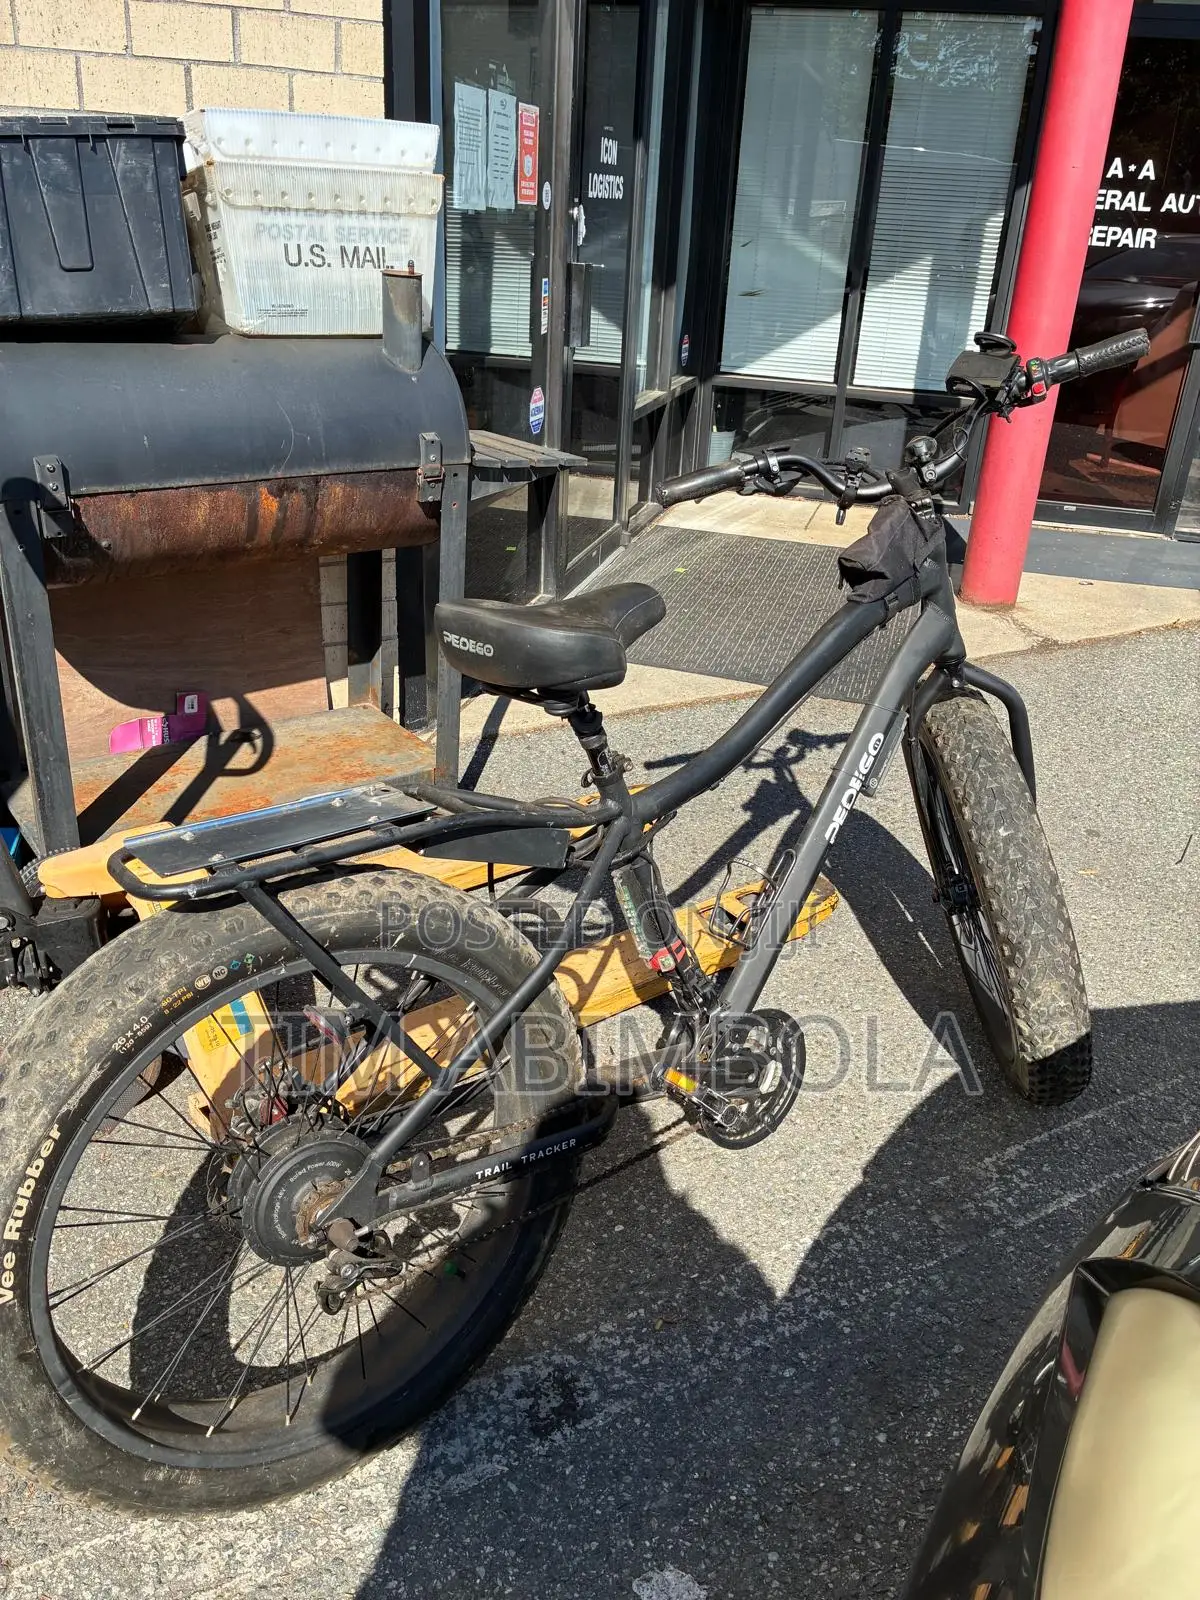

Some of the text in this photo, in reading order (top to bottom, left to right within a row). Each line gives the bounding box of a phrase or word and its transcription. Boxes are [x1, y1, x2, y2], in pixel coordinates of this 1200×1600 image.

[600, 136, 618, 166] ICON
[588, 172, 624, 200] LOGISTICS
[1160, 193, 1200, 214] AU
[255, 223, 410, 245] POSTAL SERVICE
[283, 243, 332, 269] U.S.
[443, 630, 494, 657] PEDEGO
[112, 1036, 127, 1052] 26
[132, 1015, 149, 1032] 4.0
[475, 1138, 577, 1180] TRAIL TRACKER
[0, 1123, 62, 1305] Vee Rubber
